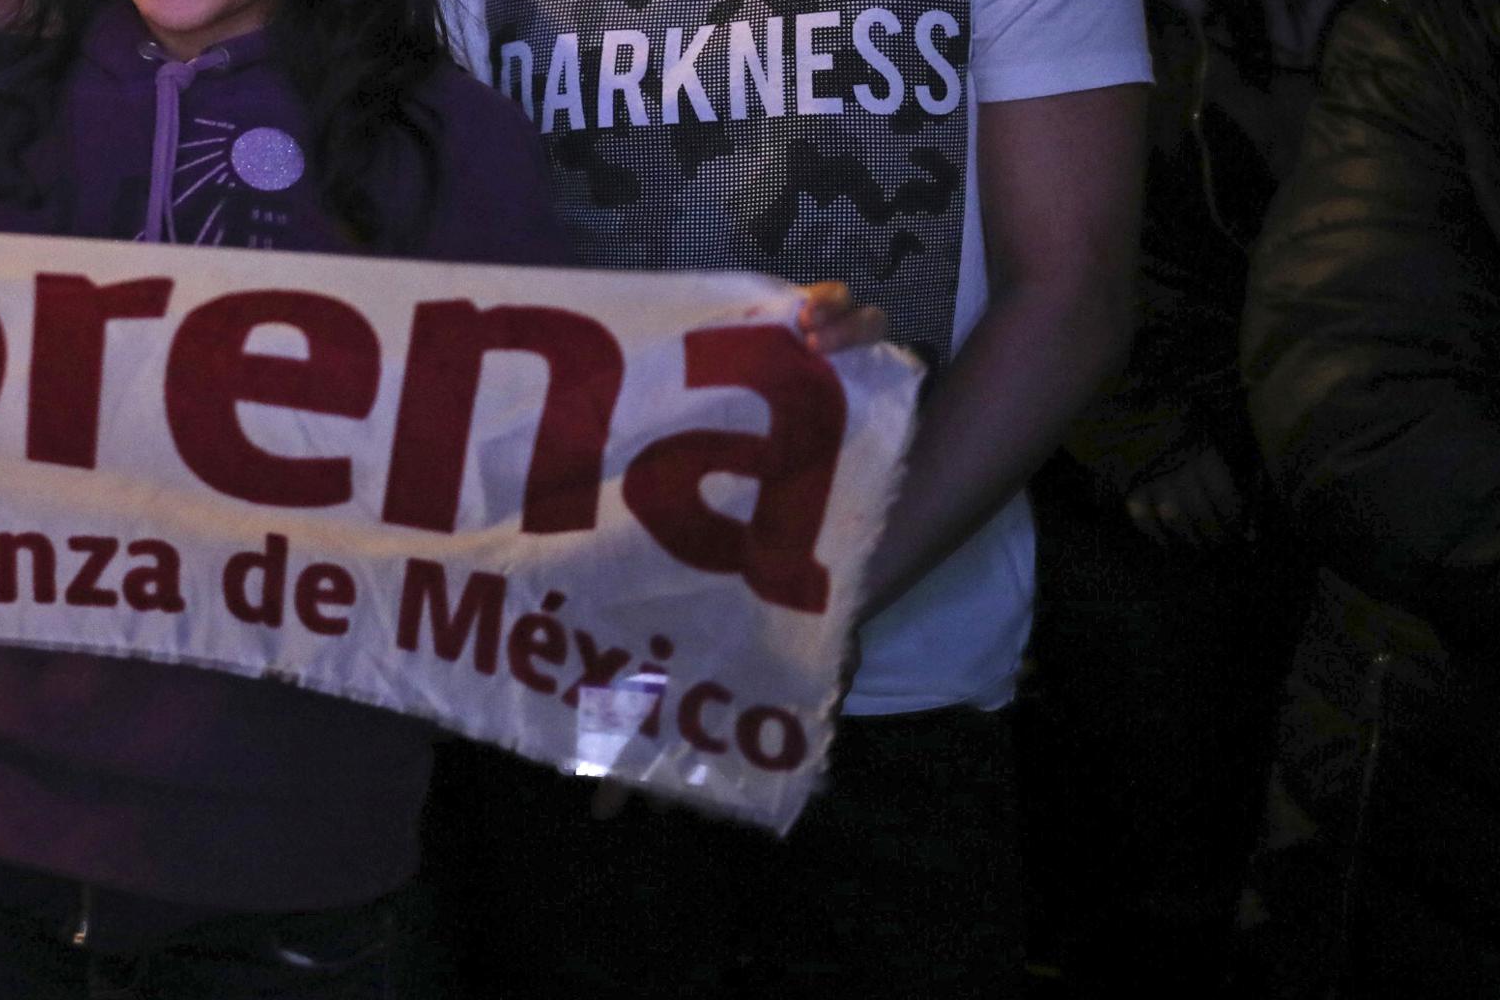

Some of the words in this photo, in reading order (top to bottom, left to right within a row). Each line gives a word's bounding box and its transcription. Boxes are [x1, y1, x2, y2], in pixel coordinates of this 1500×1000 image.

[501, 7, 962, 134] DARKNESS
[222, 533, 356, 636] de
[396, 558, 807, 772] México
